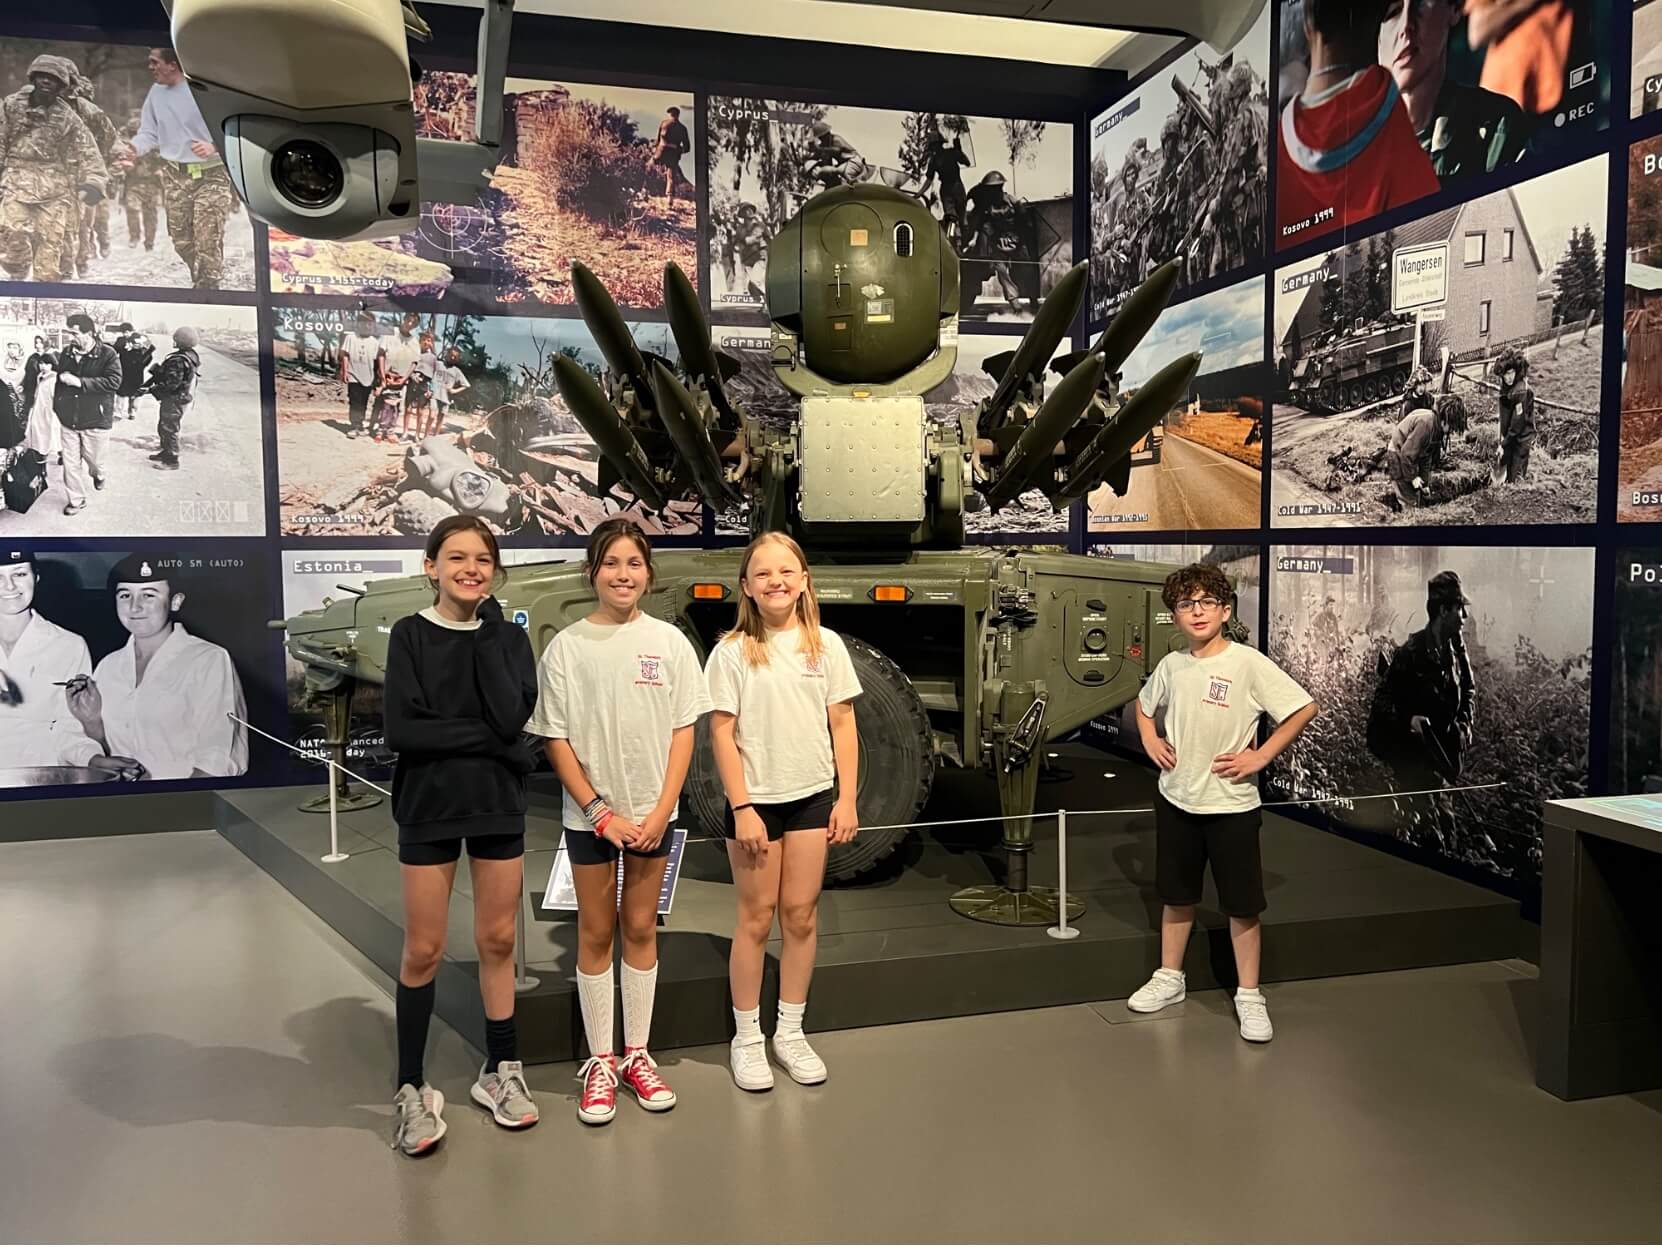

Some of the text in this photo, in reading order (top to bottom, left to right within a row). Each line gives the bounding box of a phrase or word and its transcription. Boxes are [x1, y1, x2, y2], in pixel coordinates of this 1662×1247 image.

[1568, 102, 1595, 121] REC
[1282, 207, 1334, 236] Kosovo 1999
[1400, 256, 1442, 275] Wangersen
[281, 272, 395, 289] Cyprus 1955-today
[720, 293, 755, 304] Cyprus
[721, 336, 771, 348] German
[1631, 491, 1662, 506] Bos
[1278, 502, 1361, 515] Cold War 1947-1991
[291, 514, 364, 524] Kosovo 1999
[725, 515, 747, 523] Cold
[157, 559, 183, 568] AUTO
[208, 559, 245, 568] (AUTO)
[1272, 776, 1291, 790] Cold
[1294, 780, 1308, 795] War
